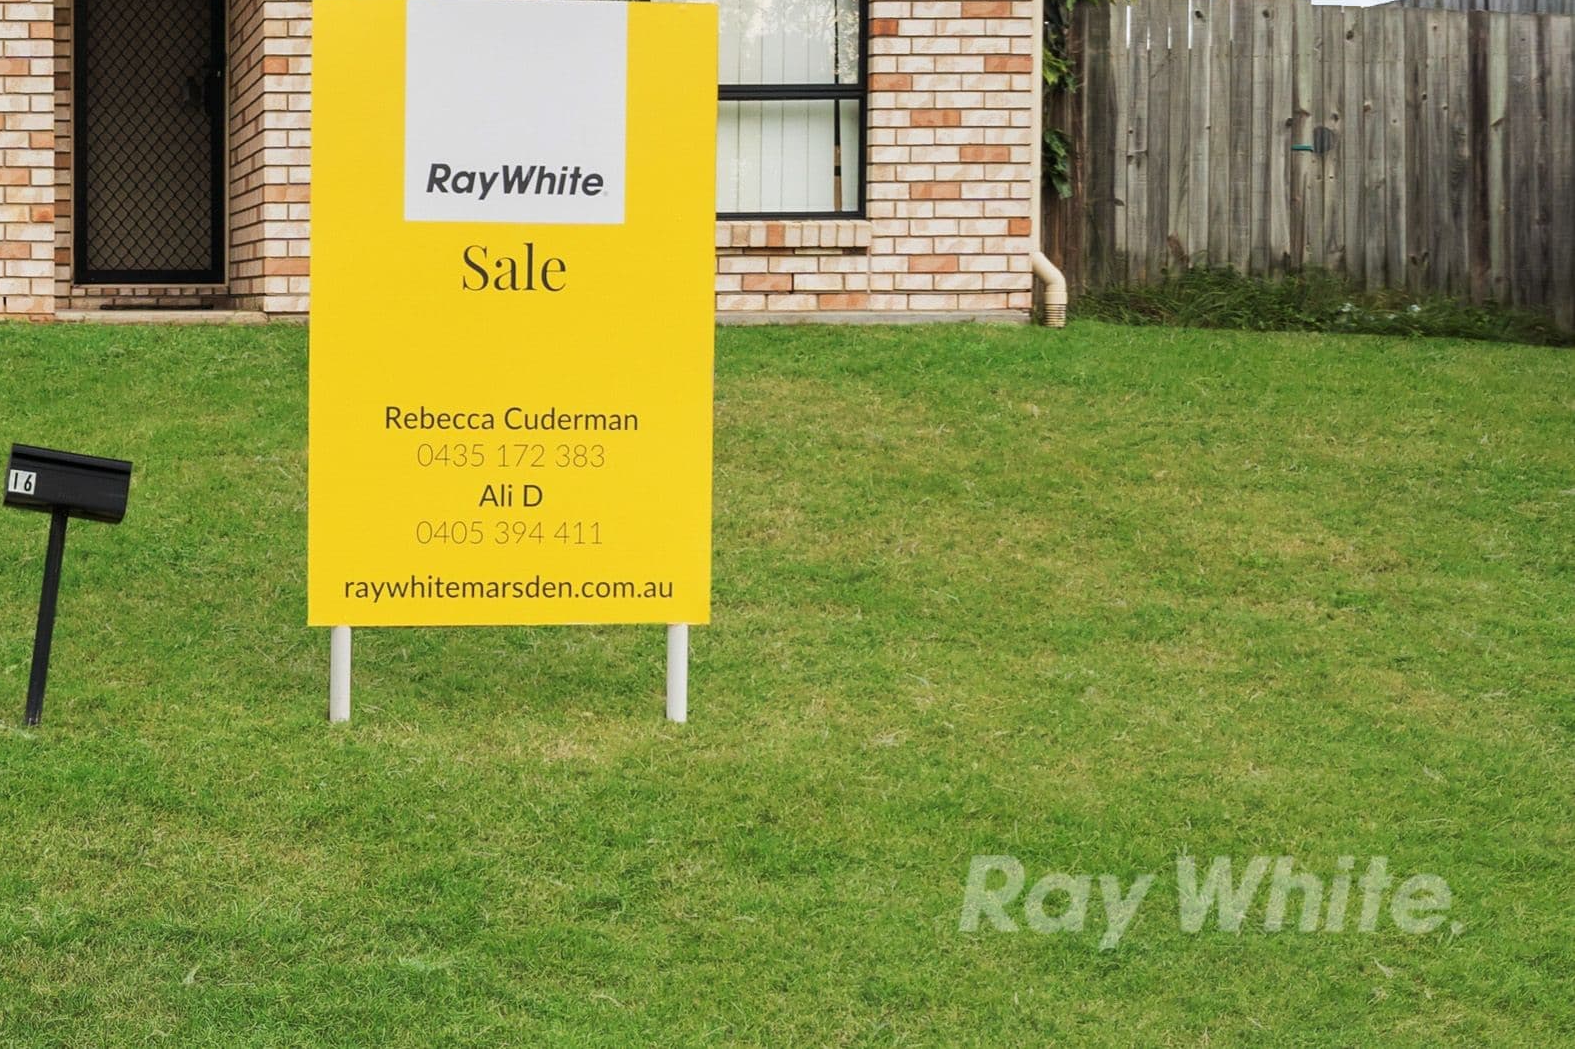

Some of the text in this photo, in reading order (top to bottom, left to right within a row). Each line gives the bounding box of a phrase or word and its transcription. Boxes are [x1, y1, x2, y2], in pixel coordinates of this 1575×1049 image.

[462, 242, 567, 292] Sale
[385, 405, 638, 431] Rebecca Cuderman
[416, 443, 605, 468] 0435 172 383
[12, 472, 33, 492] 16
[478, 483, 544, 507] Ali D
[415, 520, 603, 545] 0405 394 411
[344, 574, 674, 603] raywhitemarsden.com.au
